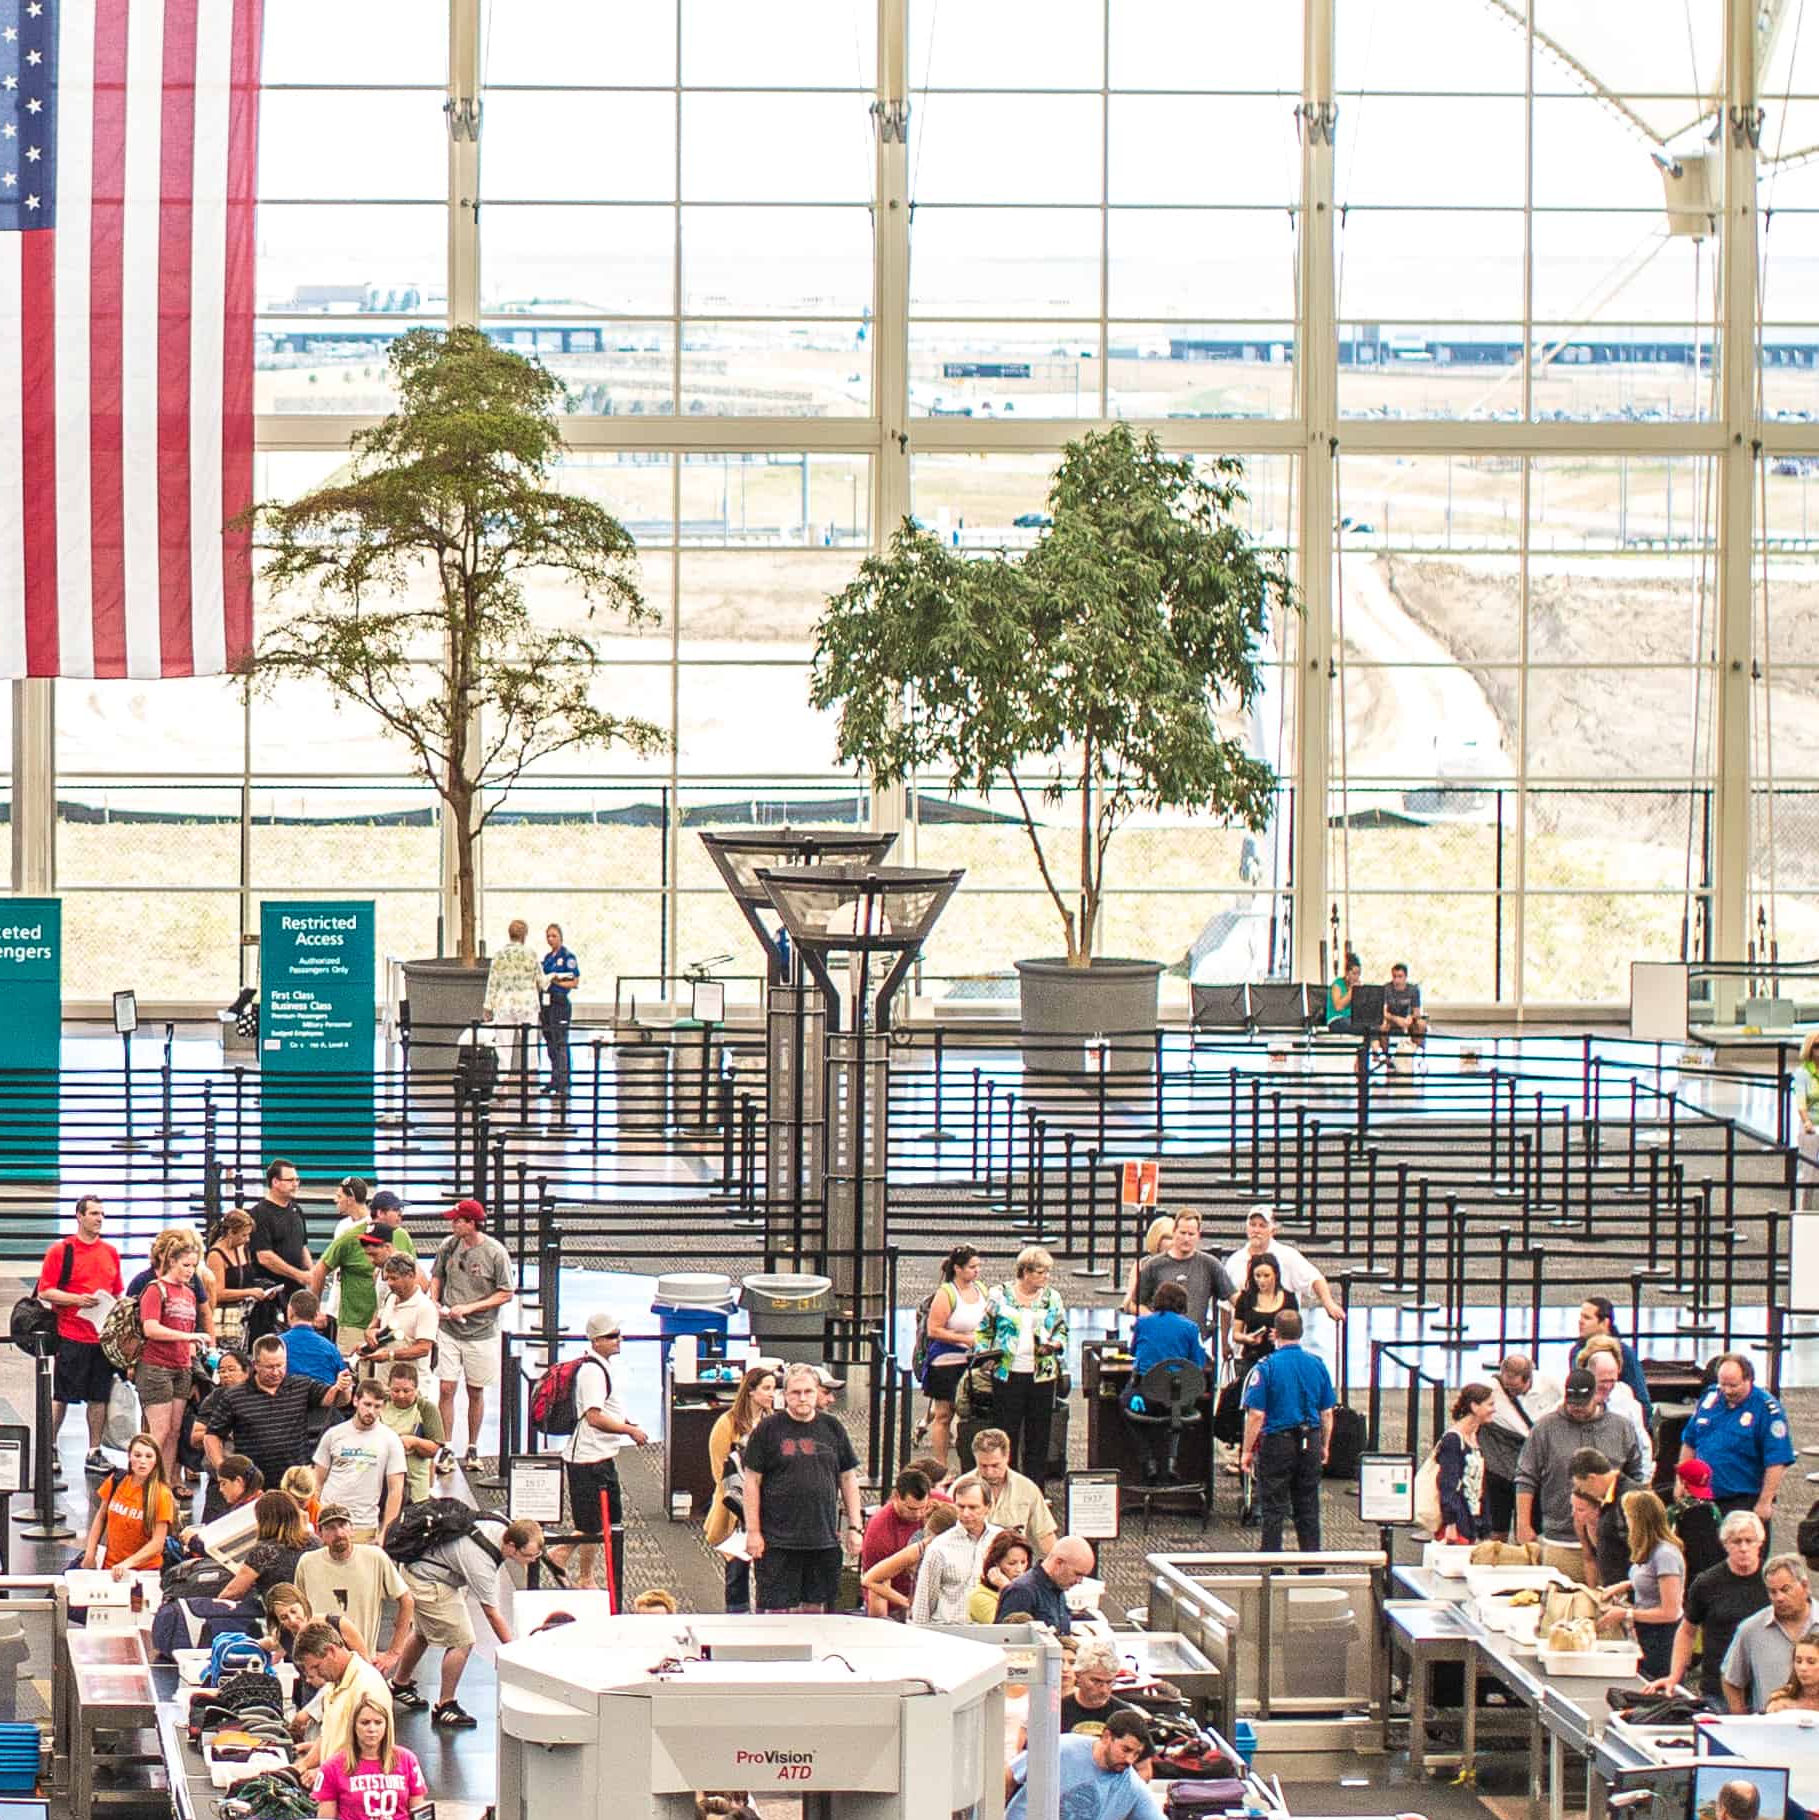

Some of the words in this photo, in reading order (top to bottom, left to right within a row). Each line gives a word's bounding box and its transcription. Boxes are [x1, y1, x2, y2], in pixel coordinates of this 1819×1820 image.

[282, 914, 357, 930] Restricted
[295, 932, 344, 946] Access
[271, 990, 290, 1000] First
[292, 990, 315, 1000] Class
[271, 1001, 308, 1011] Business
[309, 1001, 332, 1011] Class
[736, 1750, 813, 1764] ProVision
[777, 1766, 813, 1780] ATD
[348, 1773, 406, 1793] KEYSTONE
[363, 1789, 398, 1817] CO
